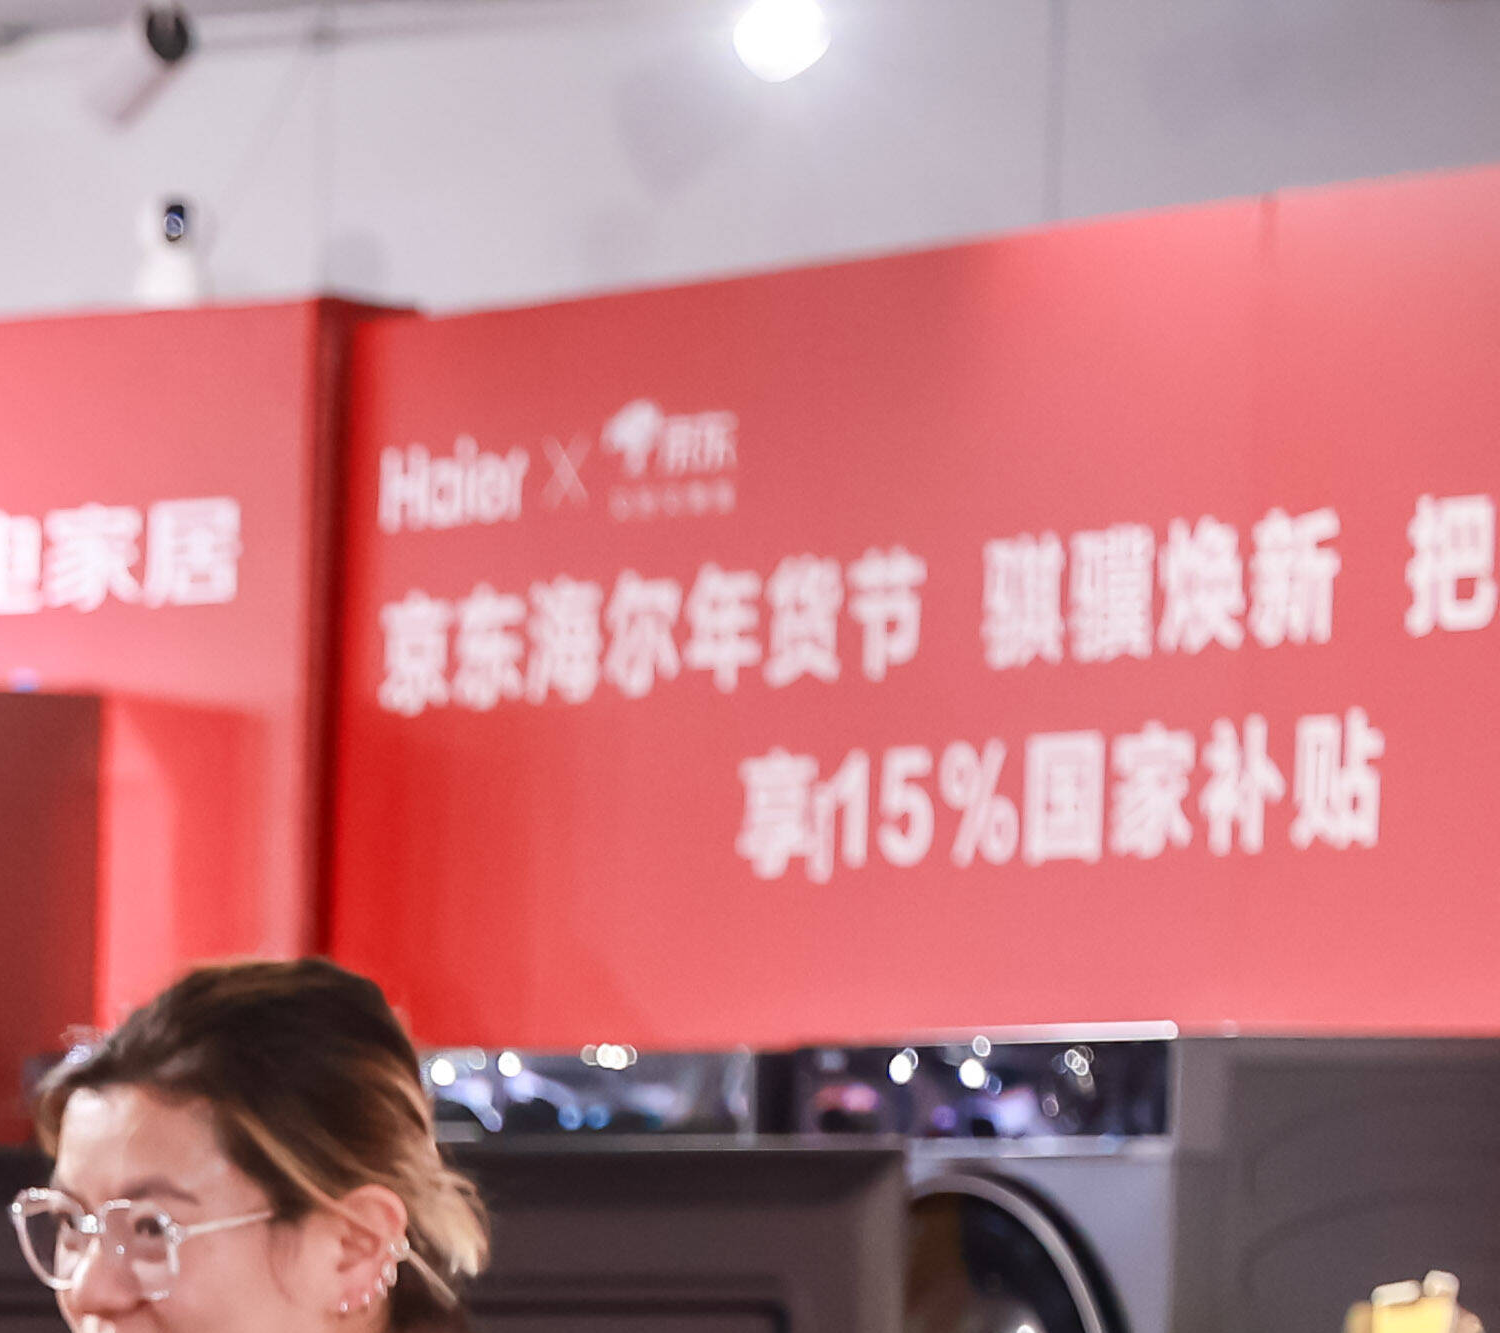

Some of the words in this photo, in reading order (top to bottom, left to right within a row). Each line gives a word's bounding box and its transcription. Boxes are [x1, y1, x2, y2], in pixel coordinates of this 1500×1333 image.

[379, 434, 530, 533] Haier
[377, 547, 927, 716] 京东海尔年货节
[1404, 494, 1499, 638] 把
